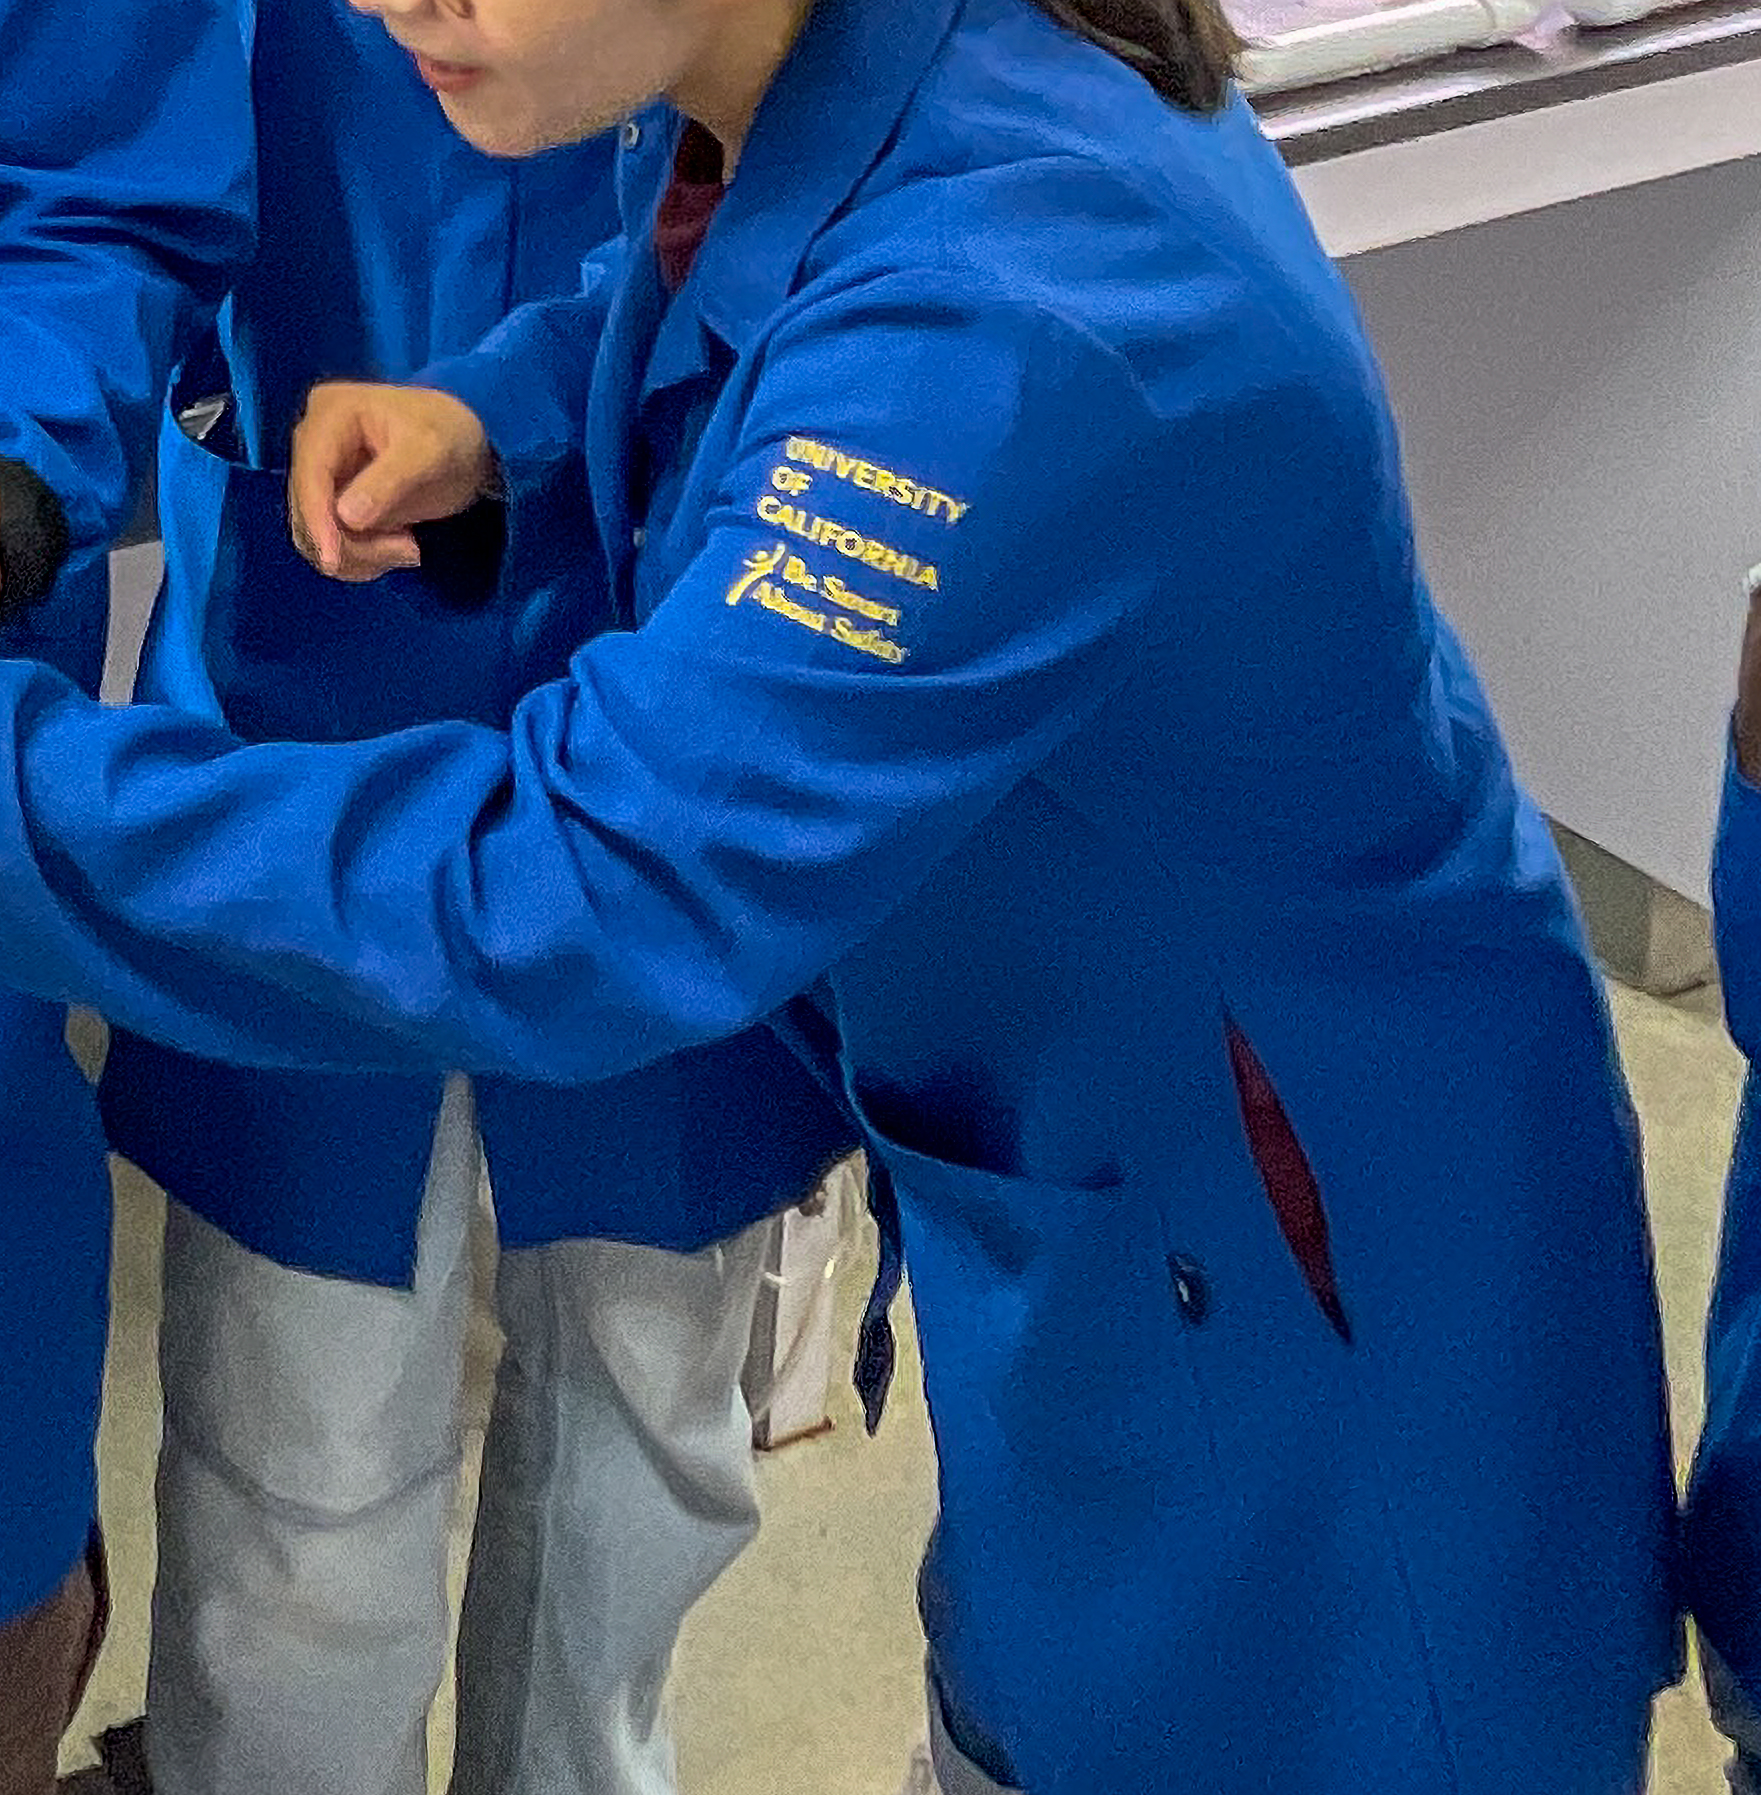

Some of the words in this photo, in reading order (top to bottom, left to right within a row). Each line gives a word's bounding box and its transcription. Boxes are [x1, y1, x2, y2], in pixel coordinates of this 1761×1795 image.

[771, 466, 813, 496] OF
[786, 435, 968, 523] UNIVERSITY
[757, 495, 938, 591] CALIFORNIA
